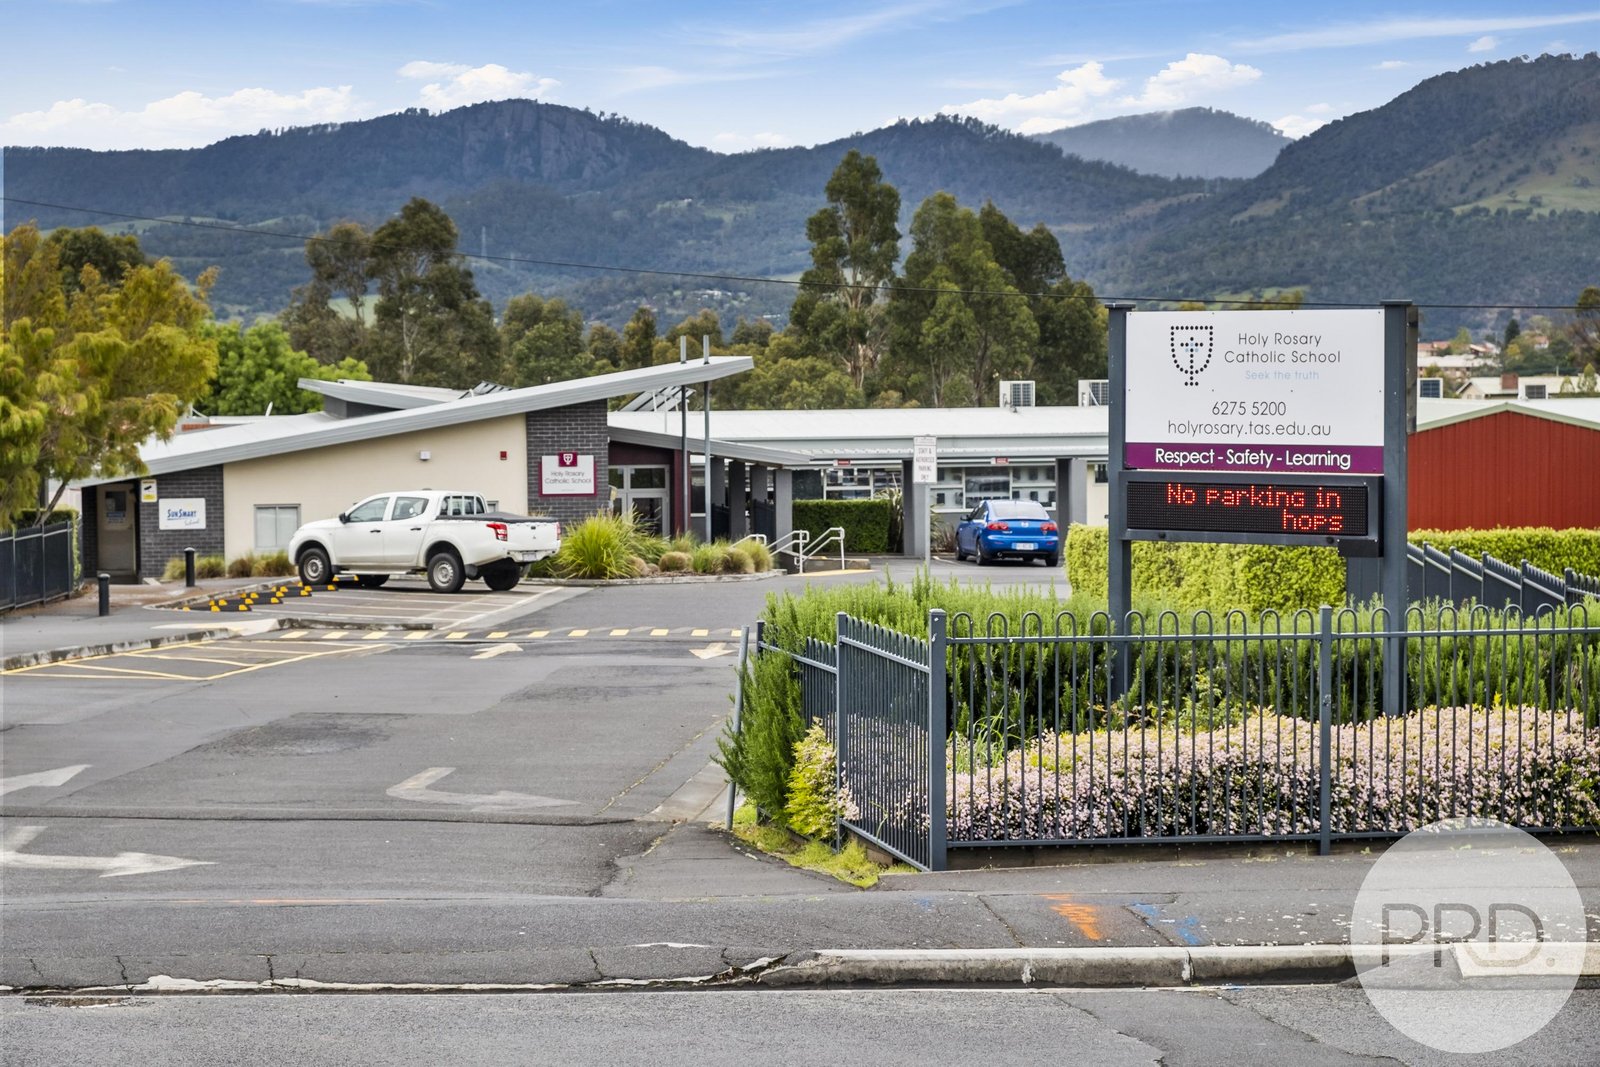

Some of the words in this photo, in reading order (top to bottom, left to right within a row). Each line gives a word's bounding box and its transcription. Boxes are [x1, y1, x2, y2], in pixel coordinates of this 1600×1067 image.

[1238, 333, 1270, 348] Holy
[1274, 333, 1322, 348] Rosary
[1224, 350, 1286, 364] Catholic
[1291, 350, 1341, 363] School
[1245, 370, 1271, 380] Seek
[1274, 370, 1292, 380] the
[1295, 370, 1319, 380] truth
[1212, 402, 1246, 416] 6275
[1251, 402, 1287, 416] 5200
[1168, 420, 1332, 437] holyrosary.tas.edu.au
[1155, 448, 1215, 466] Respect
[1226, 449, 1274, 468] Safety
[1285, 450, 1351, 469] Learning
[1168, 483, 1196, 504] No
[1206, 485, 1304, 508] parking
[1316, 487, 1341, 508] in
[1283, 509, 1343, 531] hops
